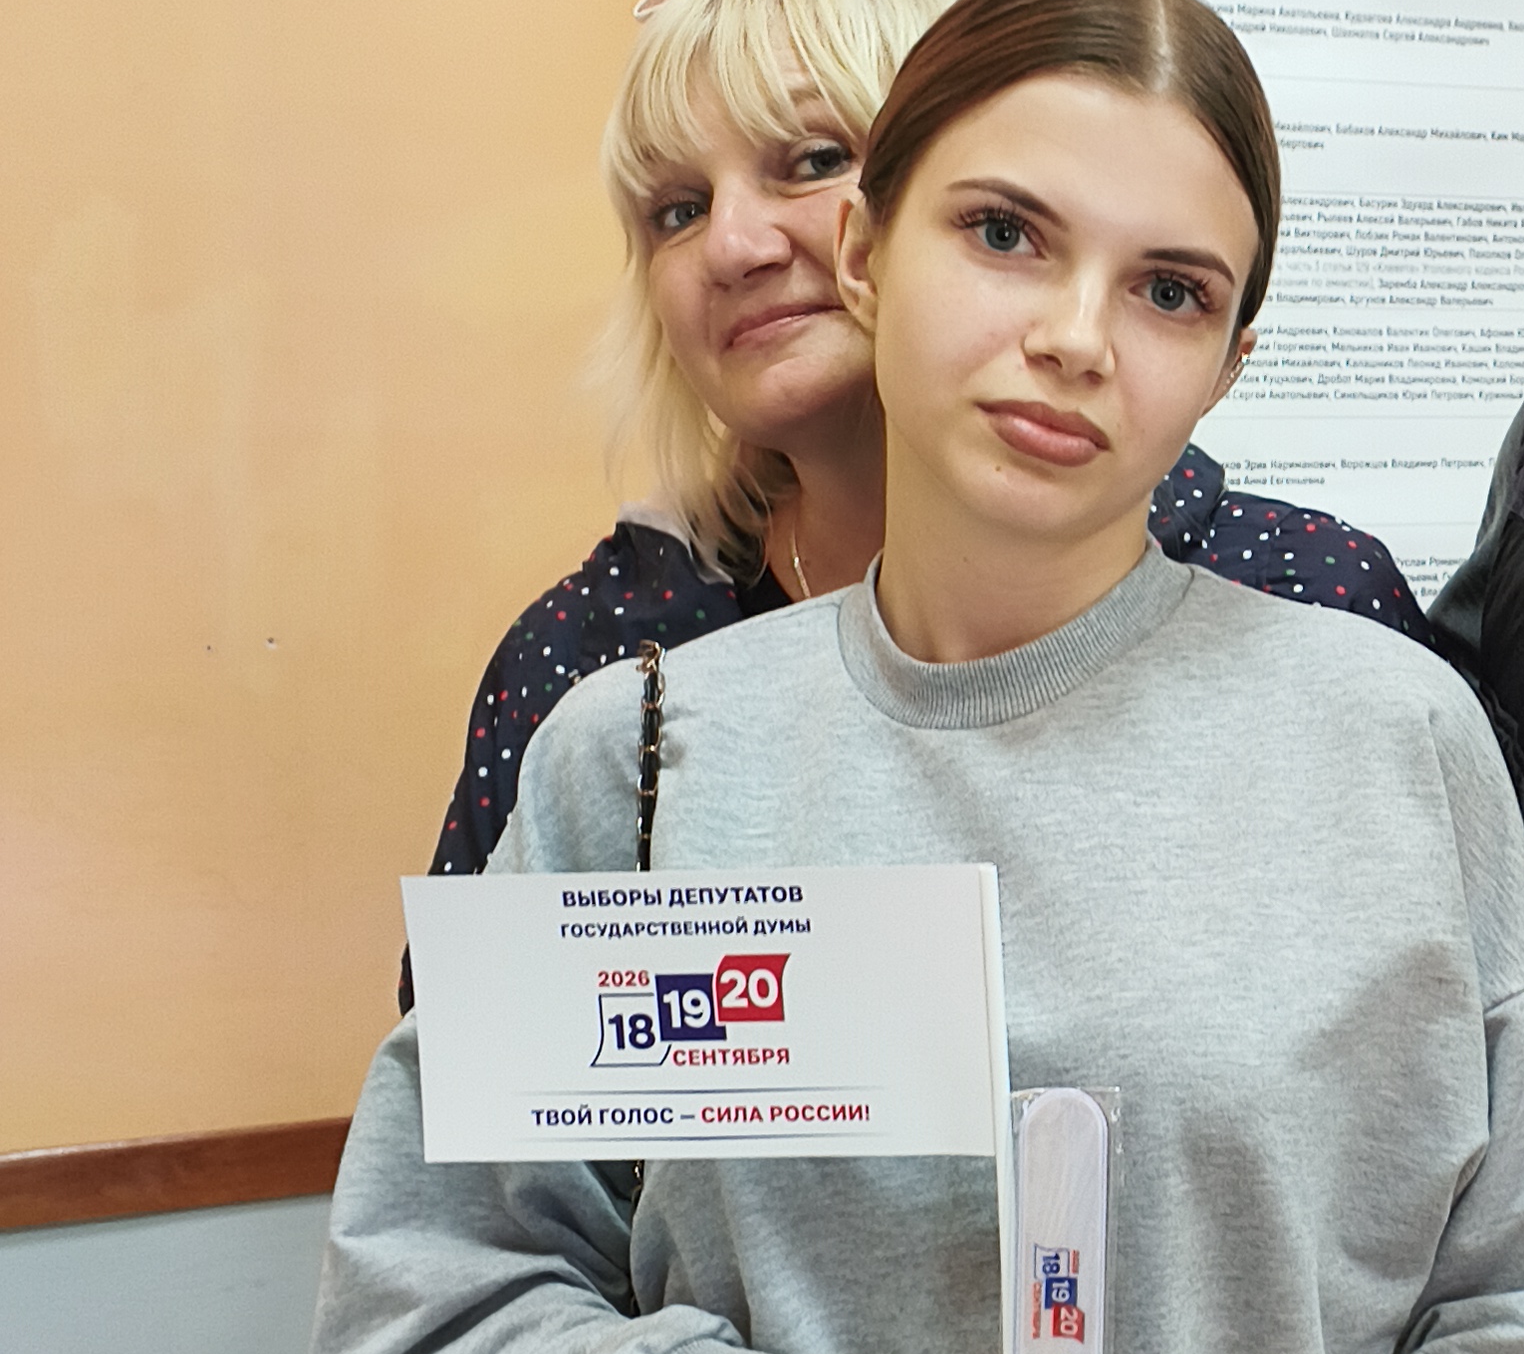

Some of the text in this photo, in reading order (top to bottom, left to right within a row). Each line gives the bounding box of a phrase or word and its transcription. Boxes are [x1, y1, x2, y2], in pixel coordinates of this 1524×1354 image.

[562, 886, 804, 908] ВЫБОРЫ ДЕПУТАТОВ
[560, 918, 811, 939] ГОСУДАРСТВЕННОЙ ДУМЫ
[598, 971, 650, 988] 2026
[719, 970, 780, 1008] 20
[663, 990, 711, 1029] 19
[608, 1013, 656, 1050] 18
[672, 1048, 790, 1066] СЕНТЯБРЯ
[532, 1105, 593, 1126] ТВОЙ
[600, 1107, 674, 1125] ГОЛОС
[701, 1106, 763, 1124] СИЛА
[770, 1104, 870, 1123] РОССИИ!
[1042, 1252, 1060, 1274] 18
[1052, 1280, 1070, 1302] 19
[1060, 1307, 1079, 1335] 20
